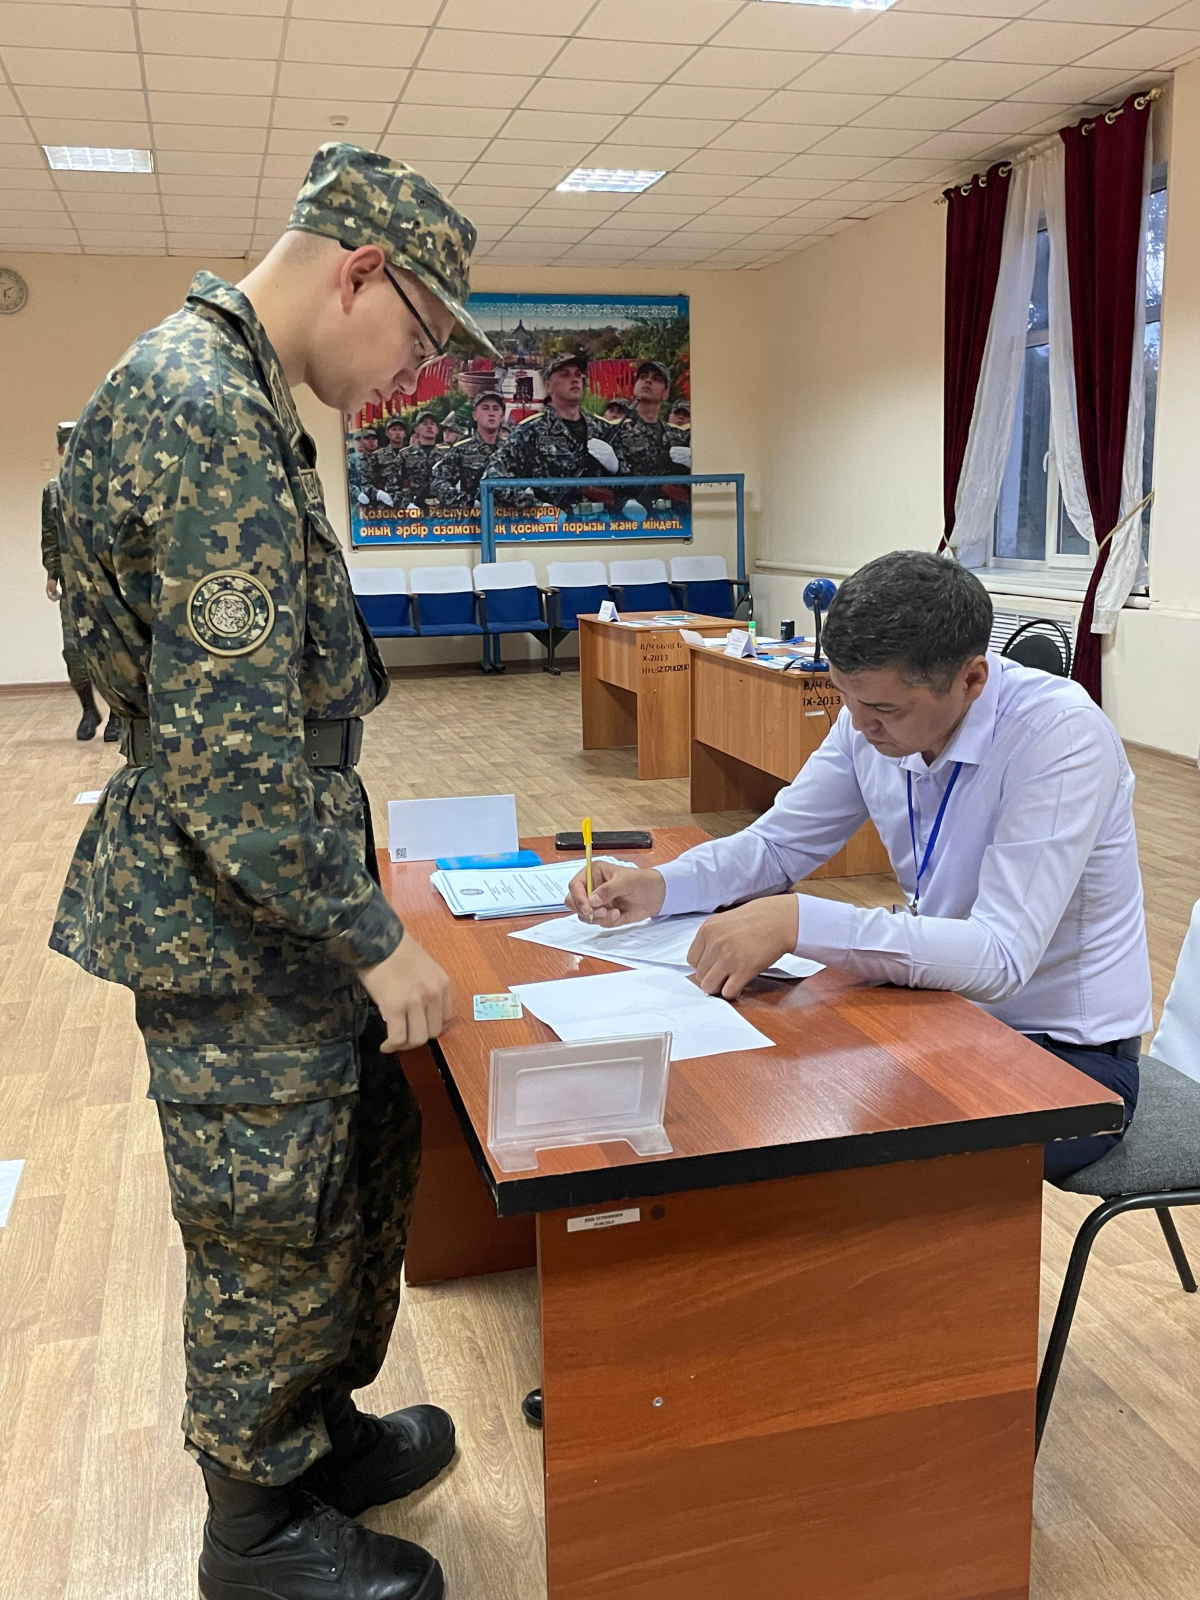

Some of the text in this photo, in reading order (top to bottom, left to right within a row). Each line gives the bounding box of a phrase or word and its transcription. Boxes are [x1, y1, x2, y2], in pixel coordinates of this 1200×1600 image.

[359, 506, 425, 520] Қазақстан
[360, 525, 392, 537] оның
[395, 523, 429, 538] әрбір
[510, 520, 558, 534] қасиетті
[562, 522, 606, 534] парызы
[609, 520, 638, 531] және
[642, 517, 683, 531] міндеті.
